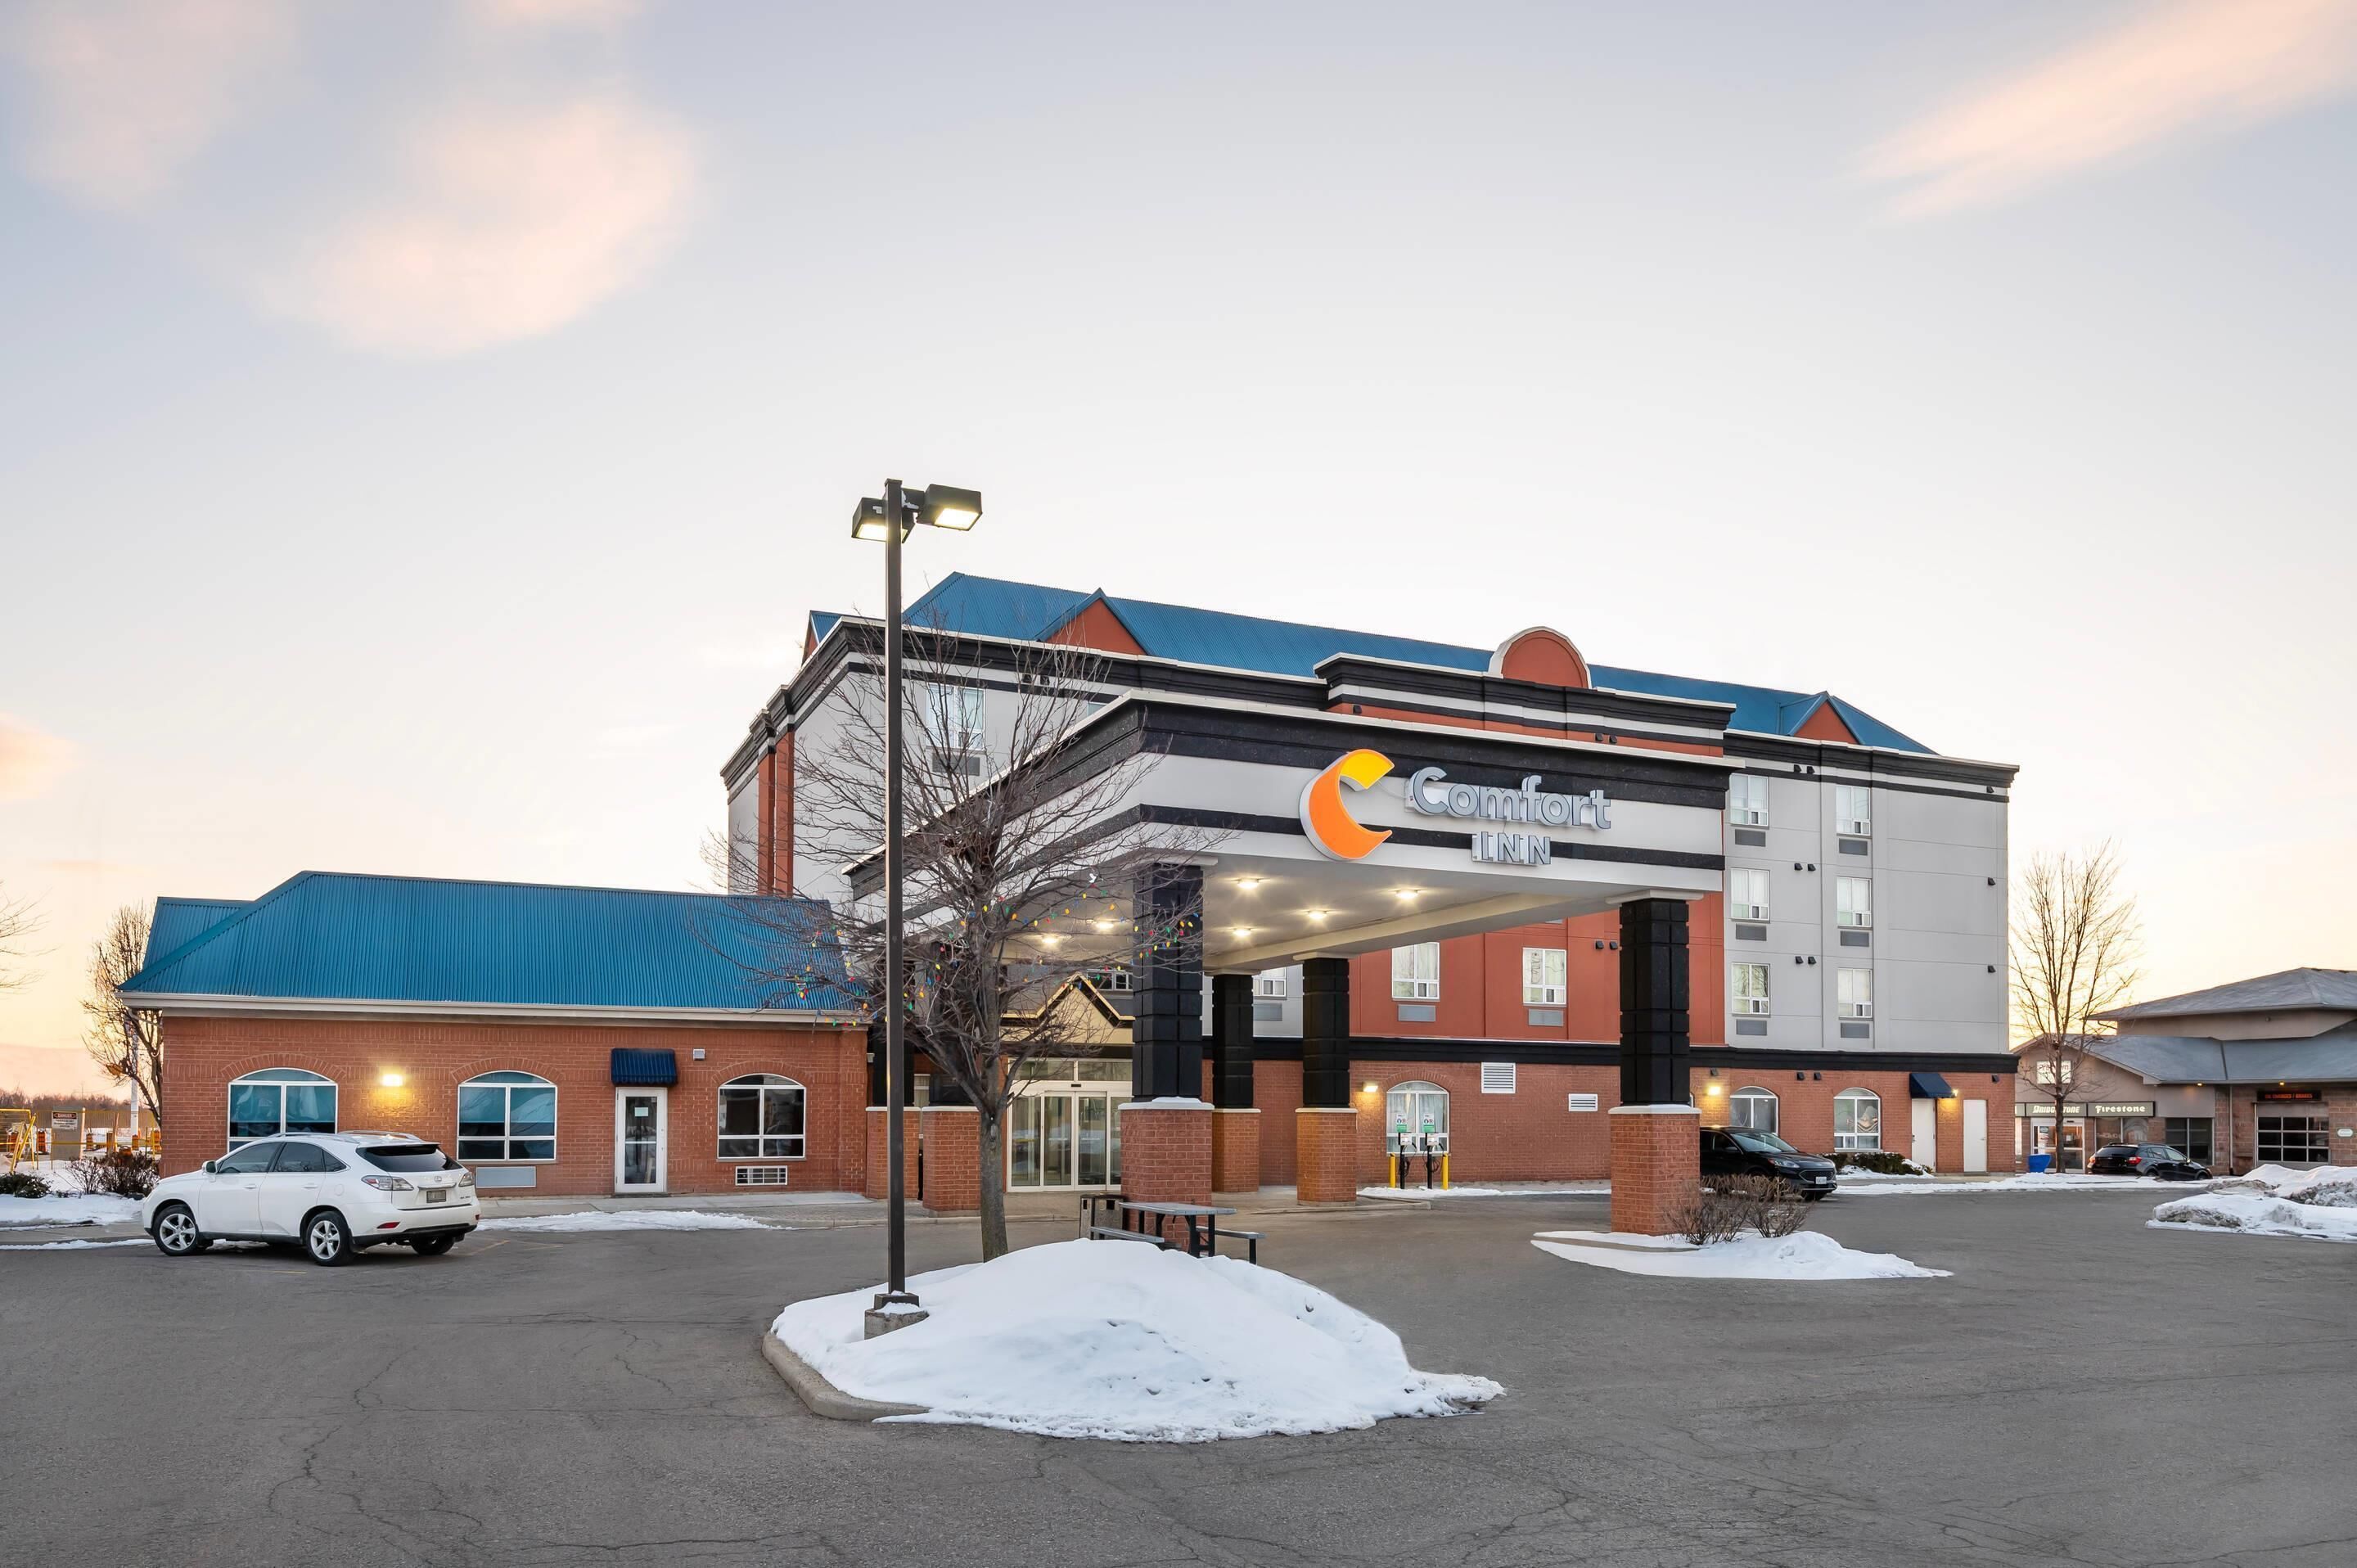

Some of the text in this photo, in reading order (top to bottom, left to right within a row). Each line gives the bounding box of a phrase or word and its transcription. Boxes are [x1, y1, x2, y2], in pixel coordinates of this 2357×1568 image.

[1411, 766, 1611, 830] Comfort
[1476, 831, 1552, 865] INN
[2033, 1105, 2146, 1114] BRIDGTONE Firestone
